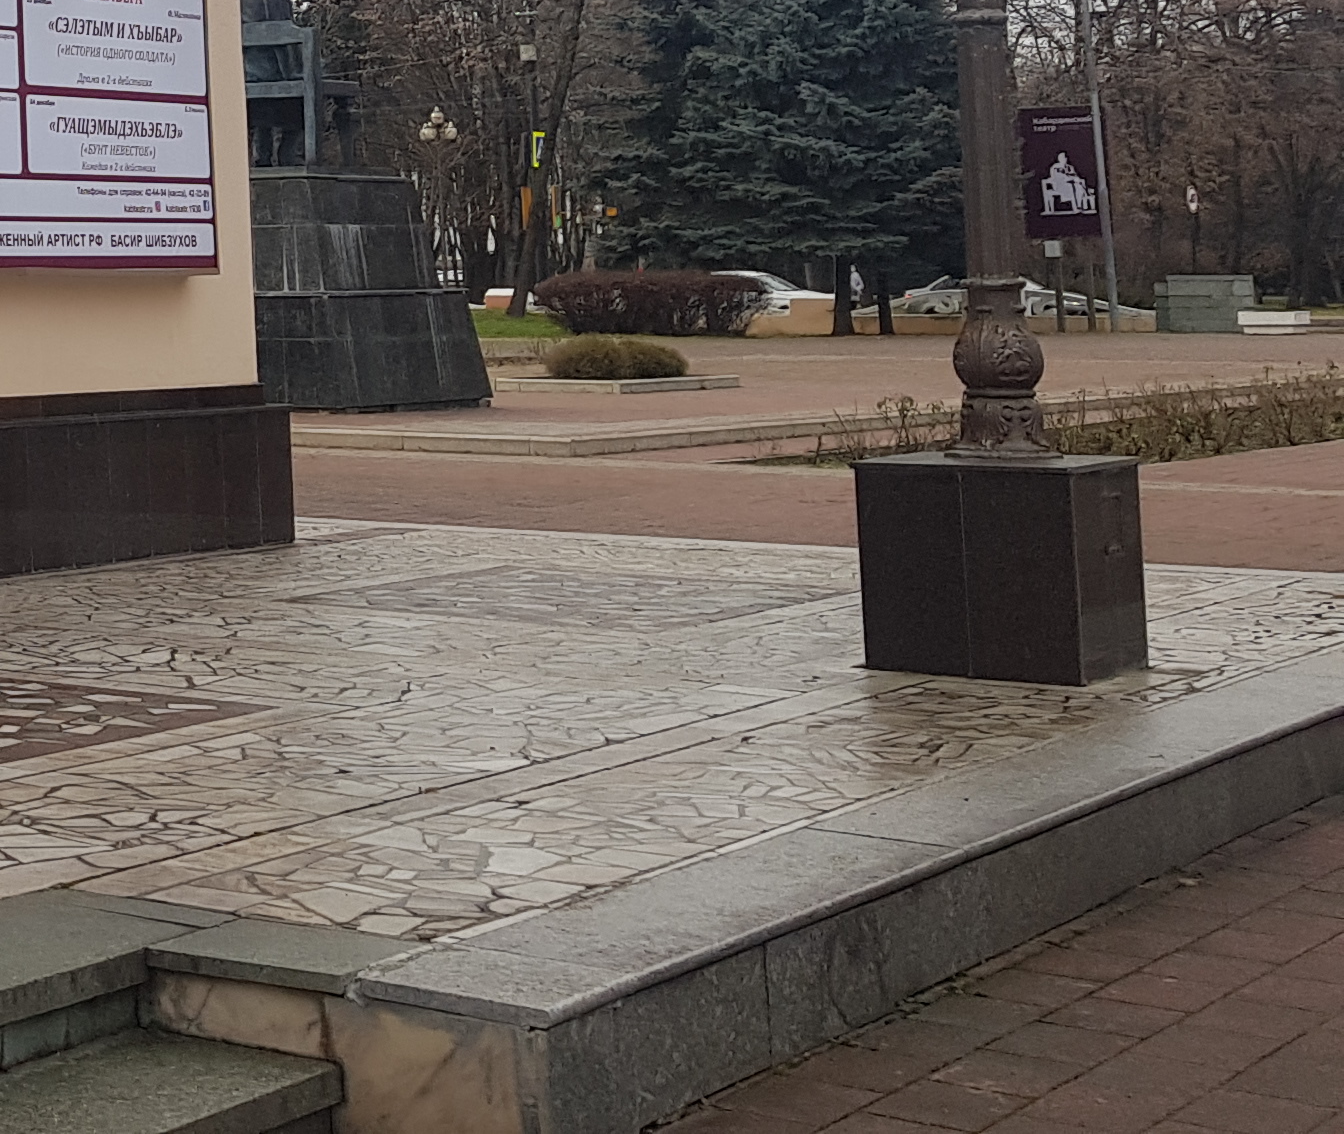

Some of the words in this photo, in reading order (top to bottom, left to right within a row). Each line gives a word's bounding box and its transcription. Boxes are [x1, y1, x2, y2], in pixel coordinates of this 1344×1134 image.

[48, 17, 114, 38] «СЭЛЭТЫМ
[116, 23, 126, 39] И
[127, 25, 182, 44] ХЪЫБАР»
[57, 44, 100, 57] («ИСТОРИЯ
[102, 47, 133, 60] ОДНОГО
[135, 50, 176, 65] СОЛДАТА»)
[77, 72, 99, 84] Драма
[49, 116, 182, 139] «ГУАЩЭМЫДЭХЬЭБЛЭ»
[47, 233, 86, 247] АРТИСТ
[89, 233, 103, 247] РФ
[111, 234, 143, 248] БАСИР
[145, 234, 197, 248] ШИБЗУХОВ
